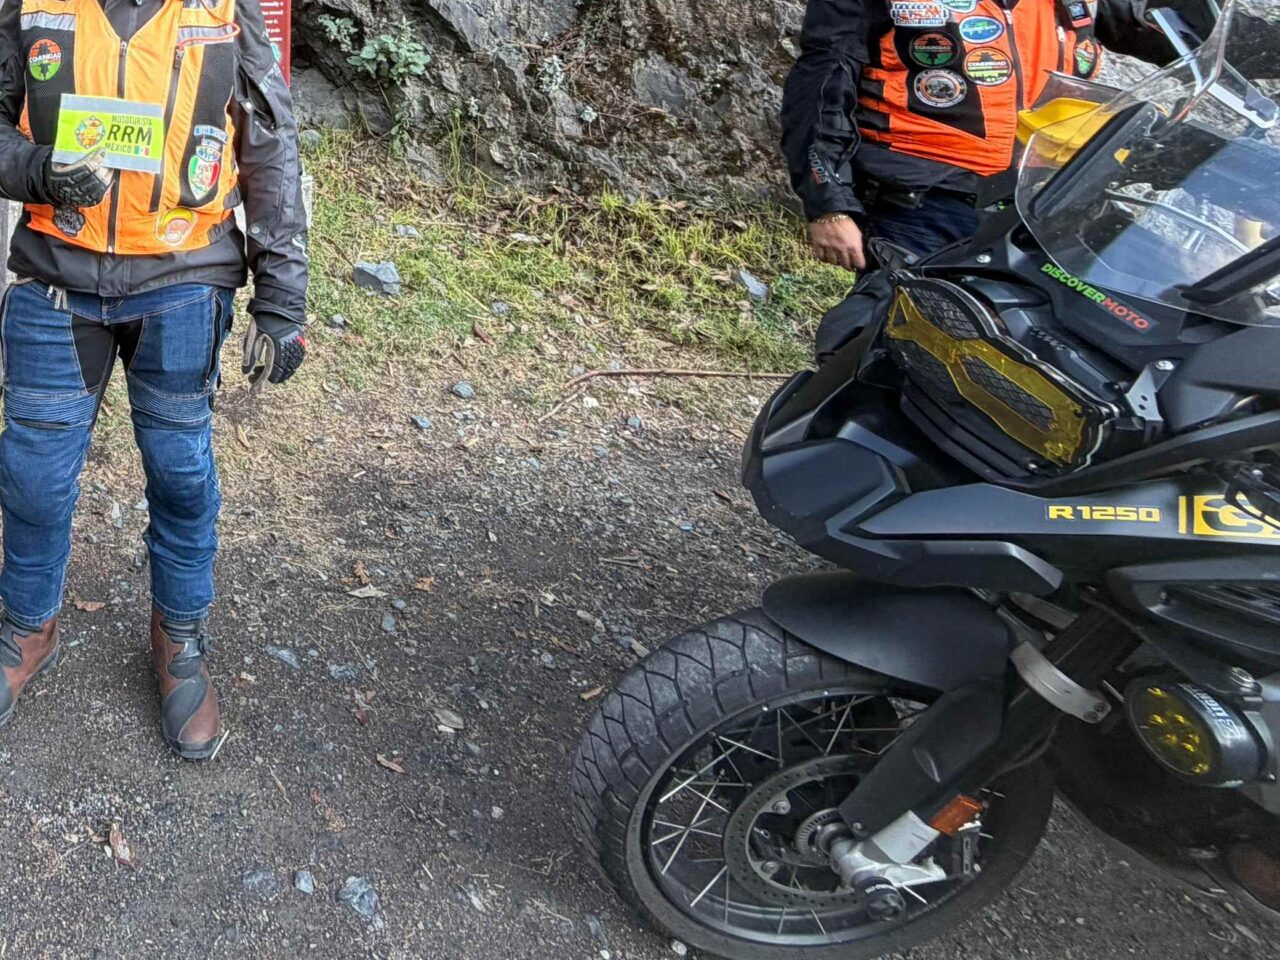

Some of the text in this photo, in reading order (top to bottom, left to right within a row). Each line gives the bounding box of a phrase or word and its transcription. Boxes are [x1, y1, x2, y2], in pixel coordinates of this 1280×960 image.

[111, 114, 152, 126] MOTOTURISTA
[106, 124, 153, 146] RRM
[1040, 263, 1149, 330] DISCOVERMOTO
